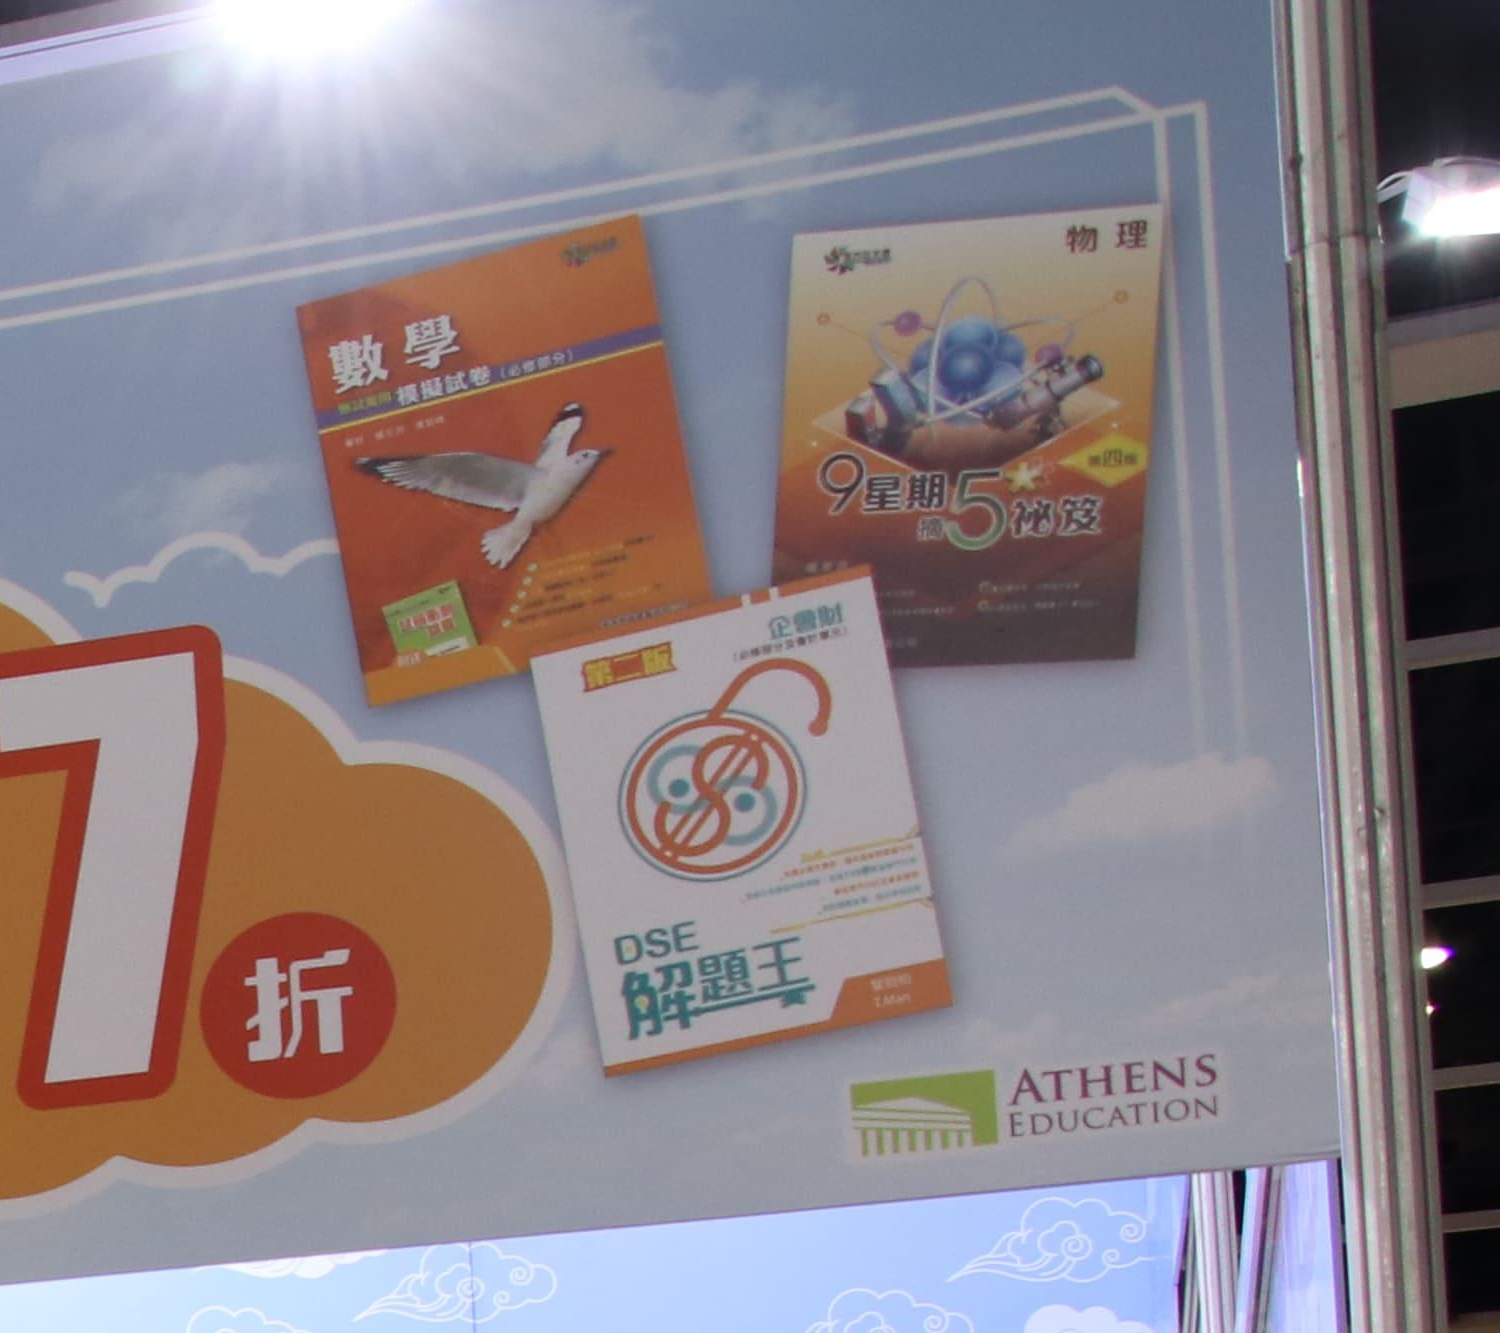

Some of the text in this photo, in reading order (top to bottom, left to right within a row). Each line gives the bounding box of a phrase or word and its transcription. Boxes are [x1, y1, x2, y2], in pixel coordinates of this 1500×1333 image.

[1065, 219, 1149, 255] 物理
[327, 313, 461, 394] 數學
[614, 920, 700, 966] DSE
[243, 948, 353, 1063] 折
[621, 937, 812, 1041] 解題王
[1007, 1053, 1218, 1107] ATHENS
[1008, 1095, 1219, 1138] EDUCATION
